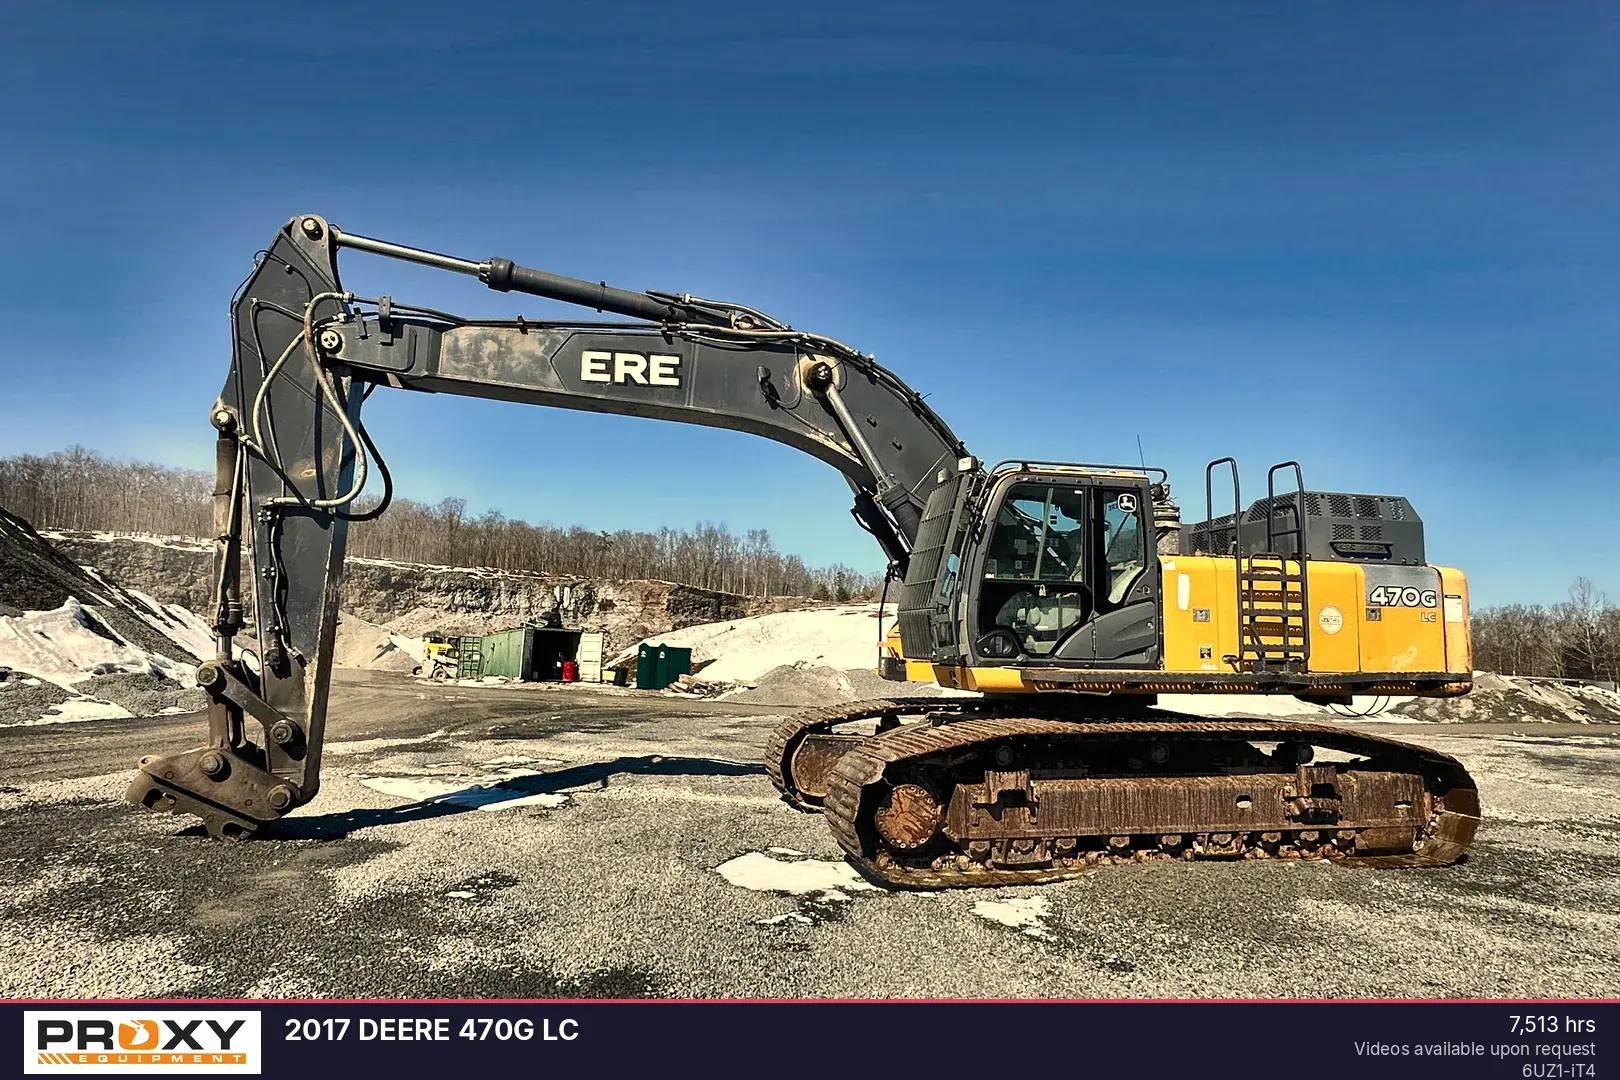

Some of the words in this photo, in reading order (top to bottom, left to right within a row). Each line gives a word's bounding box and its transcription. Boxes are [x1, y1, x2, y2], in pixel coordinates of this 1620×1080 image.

[581, 351, 680, 386] ERE
[1370, 586, 1436, 608] 470G
[1421, 612, 1436, 622] LC
